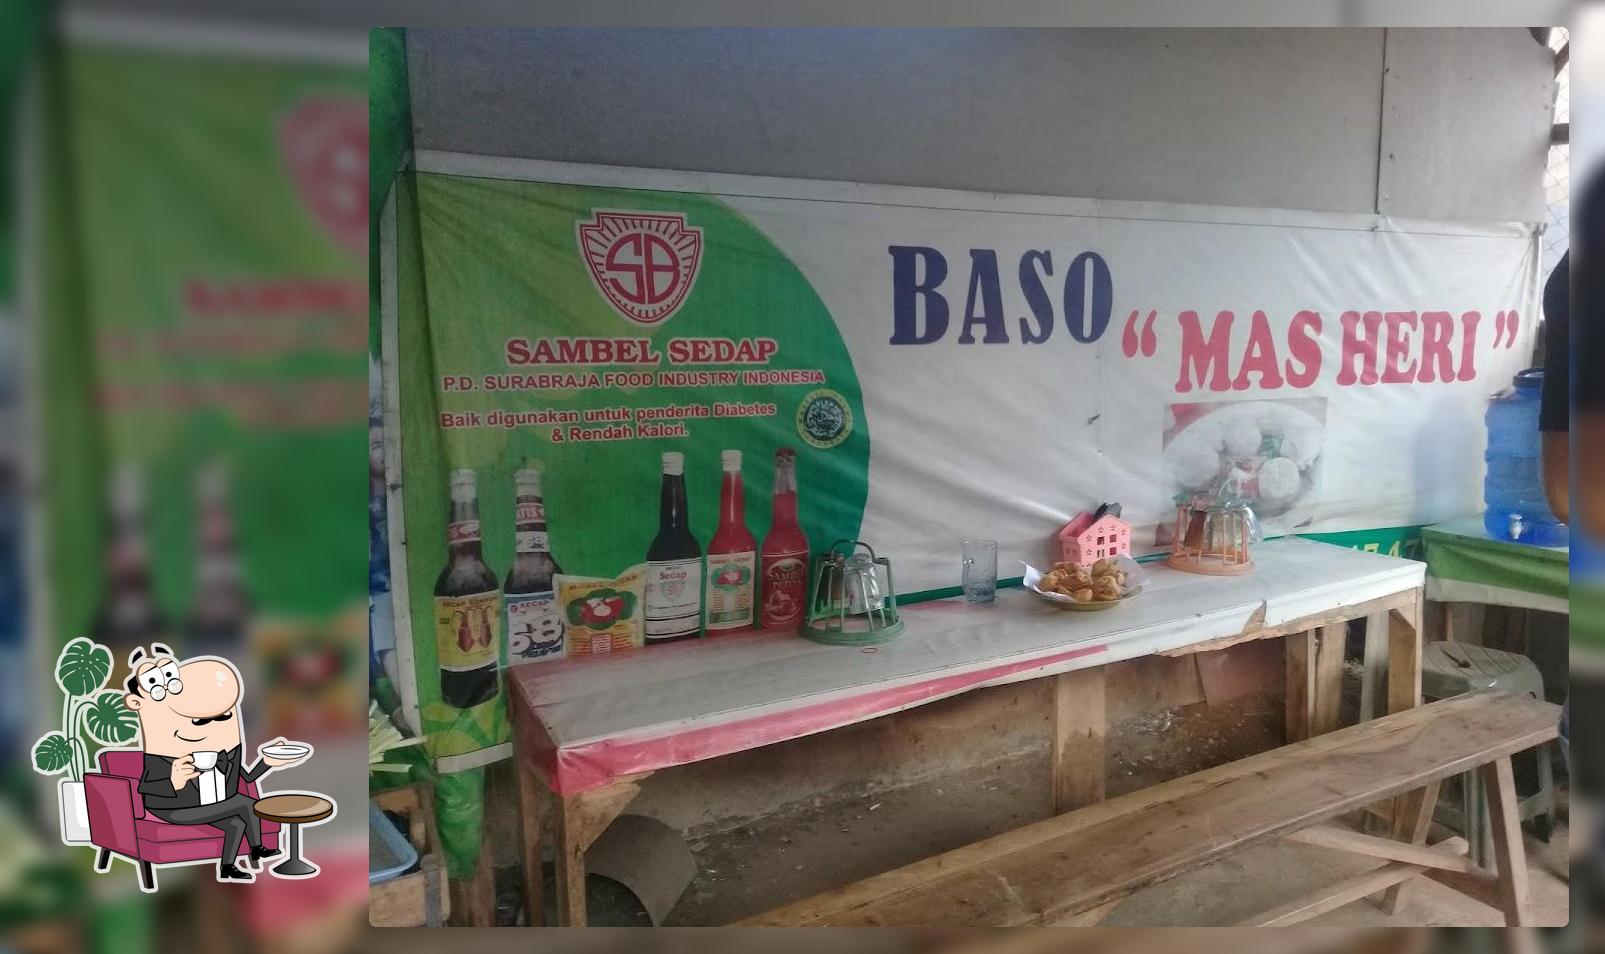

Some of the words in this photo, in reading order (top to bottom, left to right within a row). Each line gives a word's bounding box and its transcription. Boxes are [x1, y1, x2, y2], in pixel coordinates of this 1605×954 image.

[888, 245, 1114, 346] BASO
[506, 338, 660, 366] SAMBEL
[668, 337, 778, 365] SEDAP
[1174, 310, 1324, 393] MAS
[1335, 309, 1482, 387] HERI
[443, 375, 479, 392] P.D.
[484, 373, 600, 391] SURABRAJA
[604, 371, 654, 388] FOOD
[658, 370, 739, 387] INDUSTRY
[743, 369, 826, 385] INDONESIA
[441, 412, 480, 428] Baik
[487, 409, 579, 430] digunakan
[584, 405, 631, 424] untuk
[636, 403, 709, 425] penderita
[714, 402, 776, 418] Diabetes
[551, 427, 566, 443] &
[569, 425, 633, 442] Rendah
[637, 422, 689, 439] Kalori.
